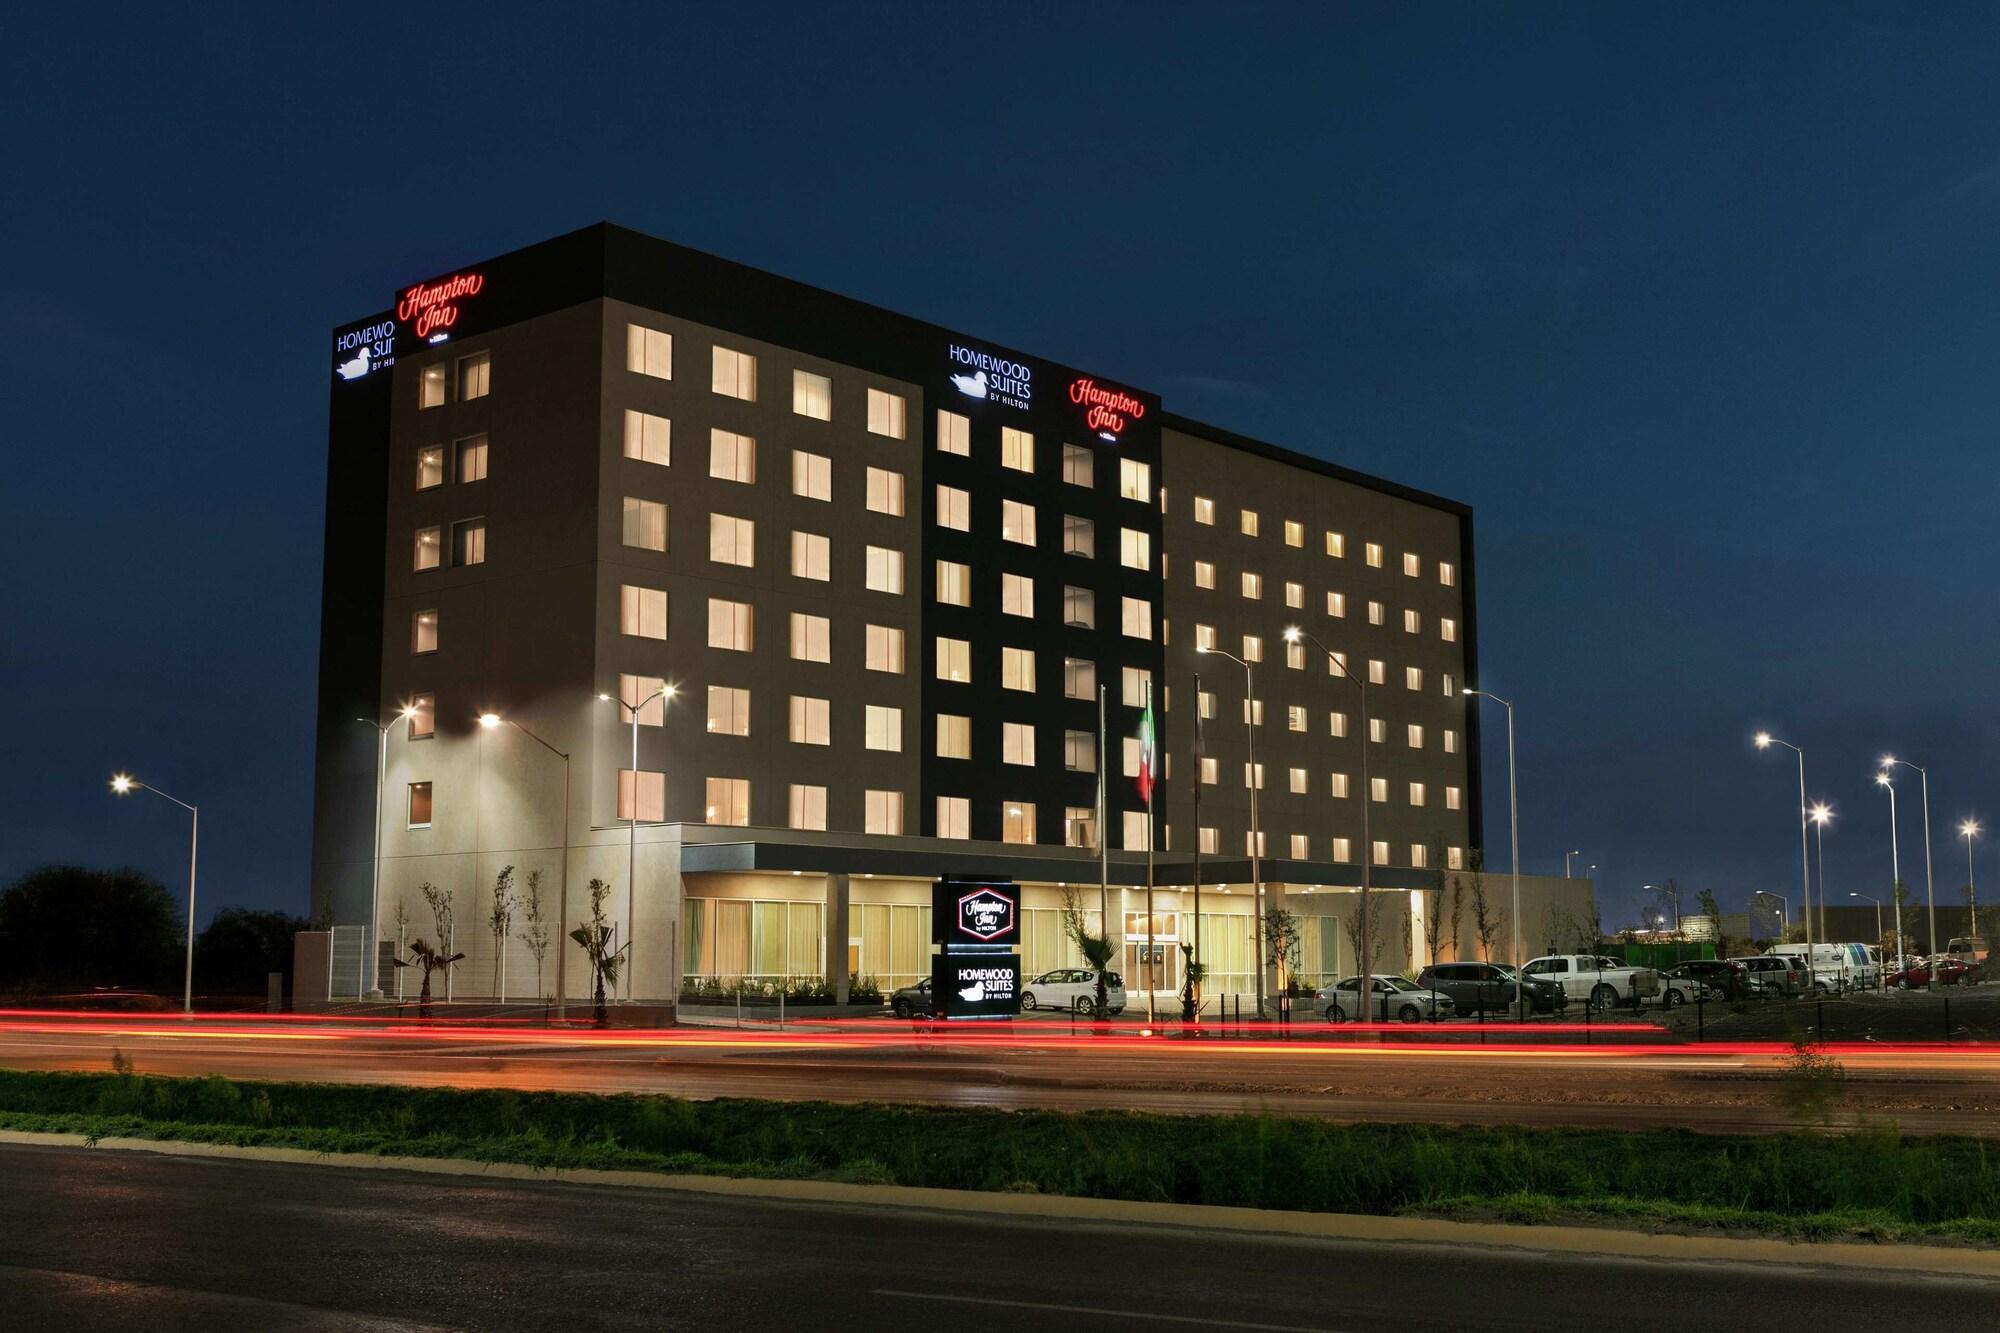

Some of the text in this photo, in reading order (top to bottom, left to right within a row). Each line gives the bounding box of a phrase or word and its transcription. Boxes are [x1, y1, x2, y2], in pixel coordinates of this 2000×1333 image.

[399, 274, 483, 321] Hampton
[416, 305, 457, 337] Inn
[337, 321, 395, 352] HOMEWO
[373, 337, 395, 357] SUI
[372, 361, 382, 371] BY
[949, 344, 1031, 382] HOMEWOOD
[990, 373, 1031, 400] SUITES
[990, 392, 1029, 411] BY HILTON
[1070, 379, 1144, 419] Hampton
[1088, 405, 1123, 432] Inn
[965, 899, 1007, 916] Hampton
[975, 912, 997, 926] Inn
[958, 968, 1013, 981] HOMEWOOD
[985, 980, 1013, 991] SUITES
